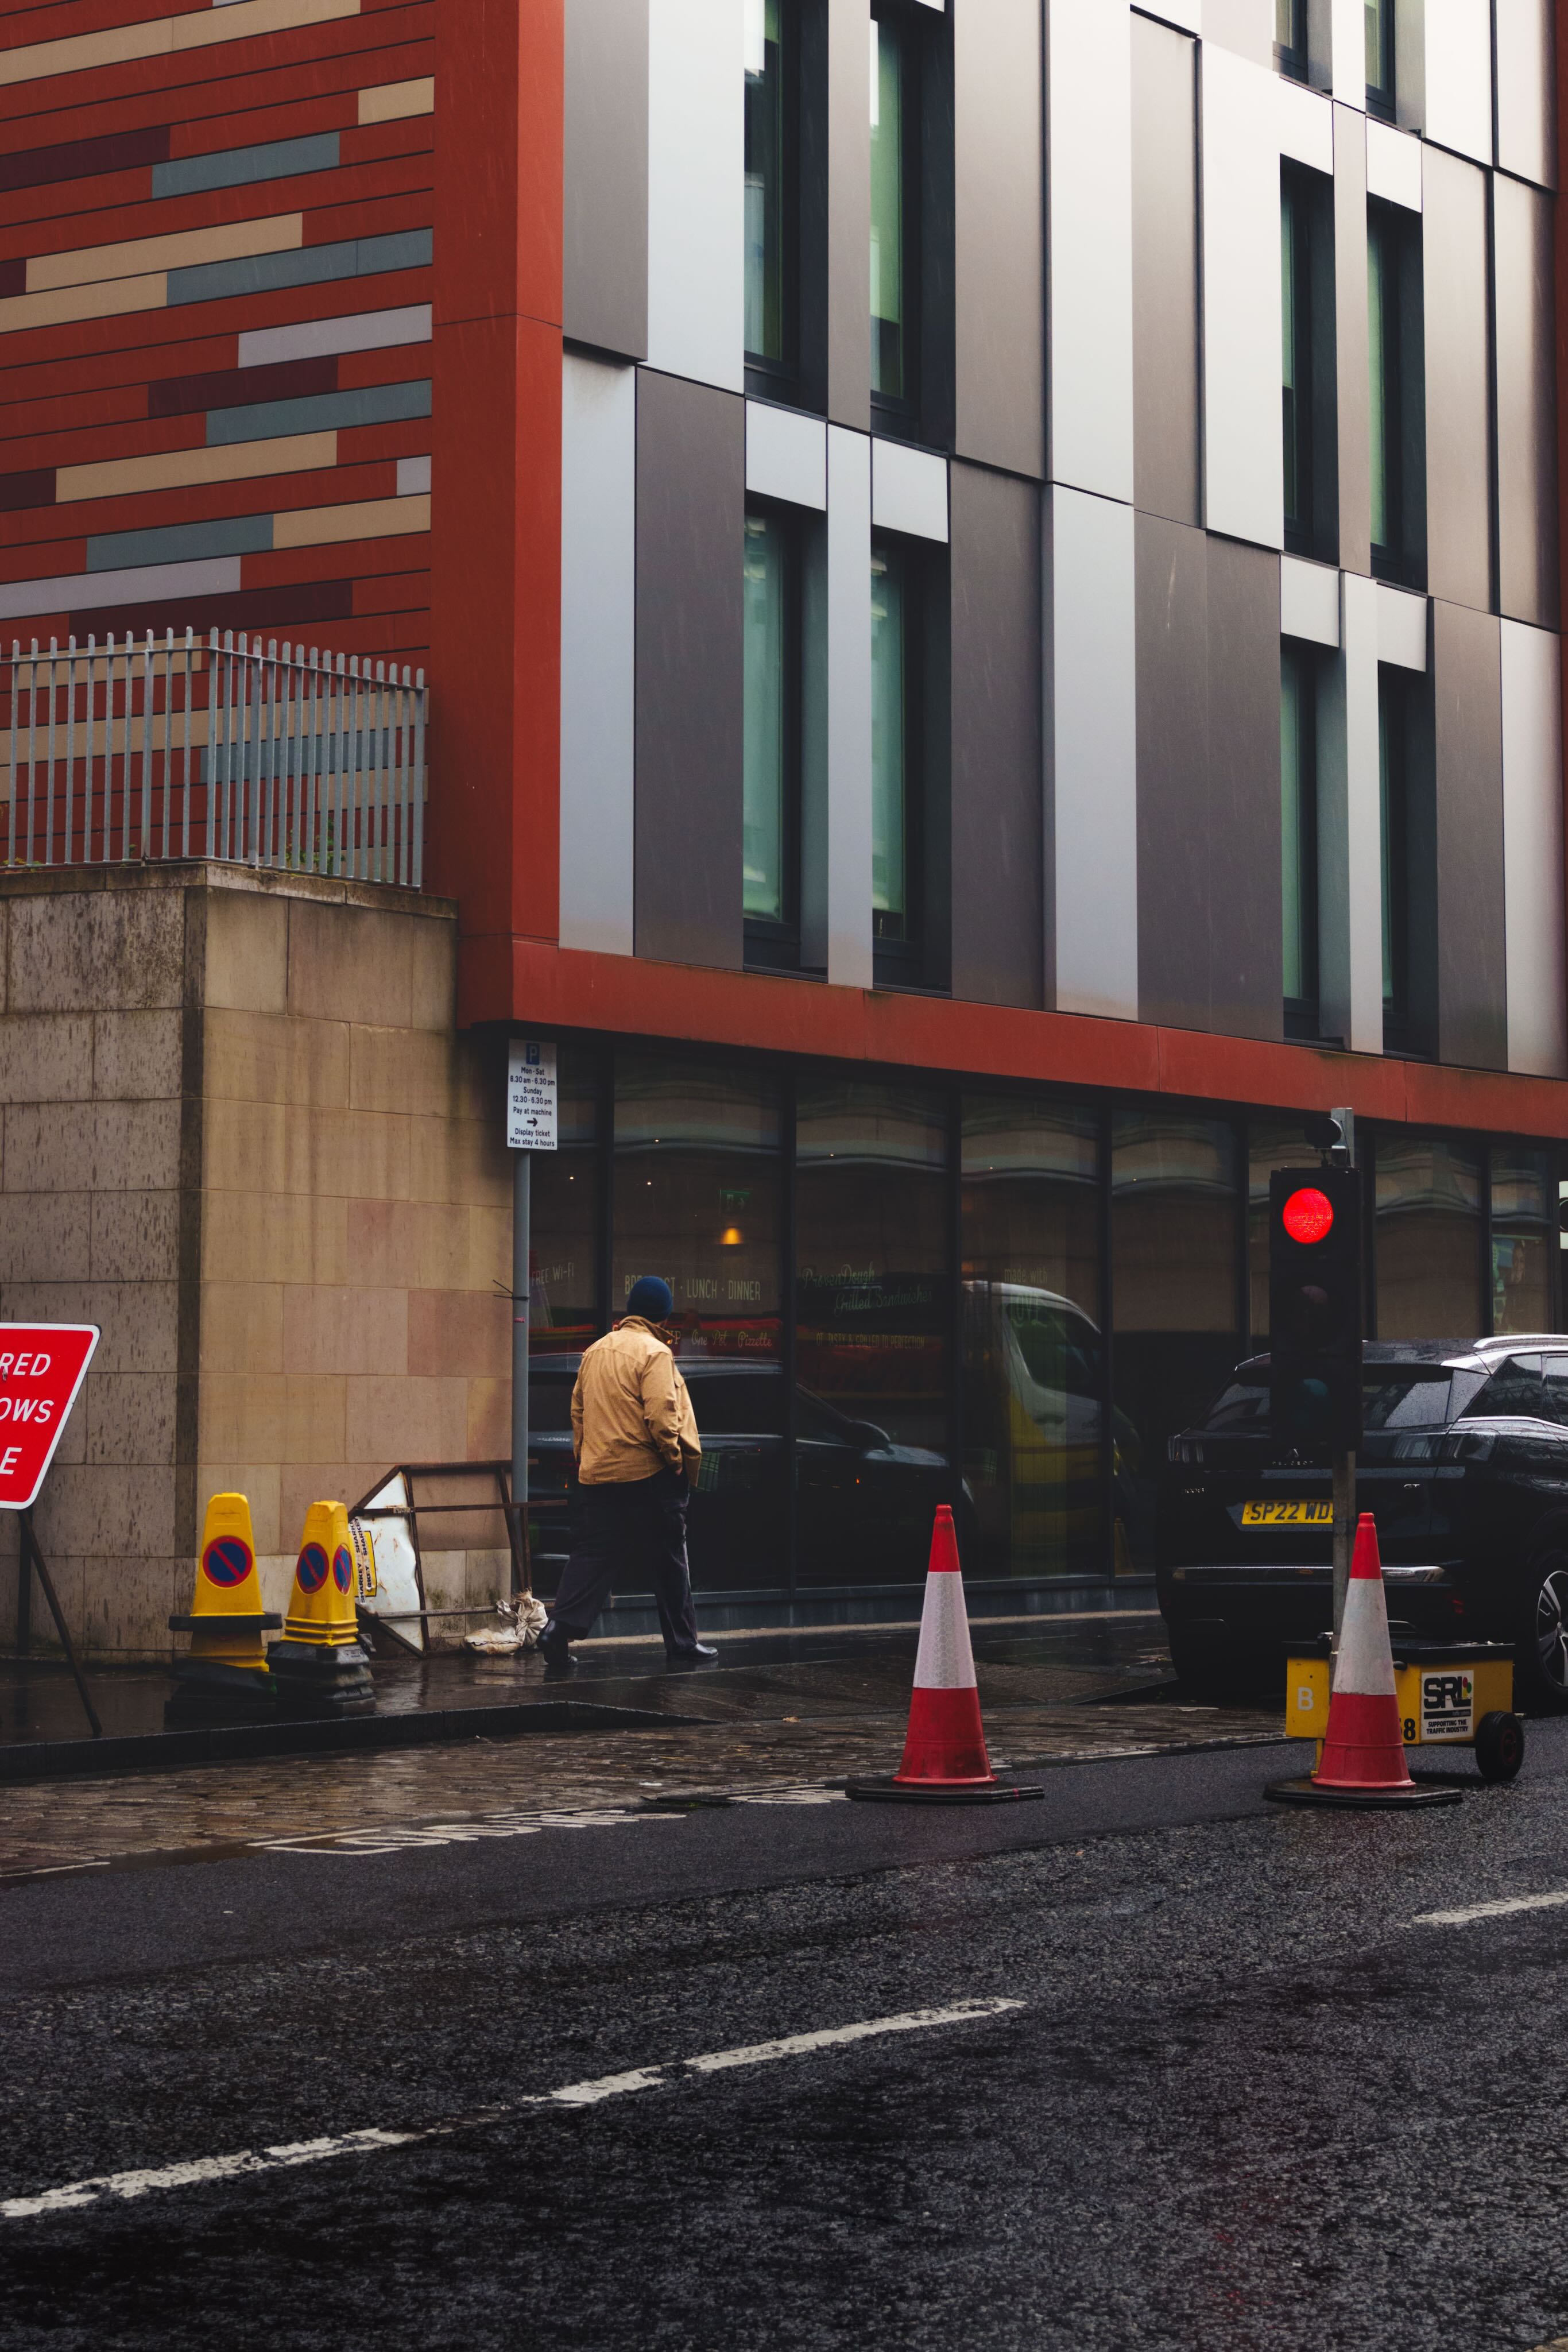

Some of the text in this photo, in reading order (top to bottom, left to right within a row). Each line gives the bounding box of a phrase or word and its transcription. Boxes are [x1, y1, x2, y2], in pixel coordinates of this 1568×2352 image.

[529, 1045, 538, 1063] P
[513, 1095, 527, 1103] 12.30
[523, 1086, 542, 1096] Sunday
[513, 1107, 522, 1115] Pay
[515, 1128, 533, 1137] Display
[522, 1139, 533, 1147] stay
[532, 1262, 574, 1287] FREE WI-FI
[687, 1278, 717, 1298] LUNCH
[728, 1280, 761, 1301] DINNER
[691, 1328, 708, 1345] One
[0, 1353, 51, 1376] RED
[0, 1447, 22, 1475] E
[1250, 1502, 1334, 1521] SP22 WD
[354, 1518, 367, 1556] SHARKEY
[1298, 1686, 1314, 1711] B
[1424, 1676, 1471, 1709] SRL
